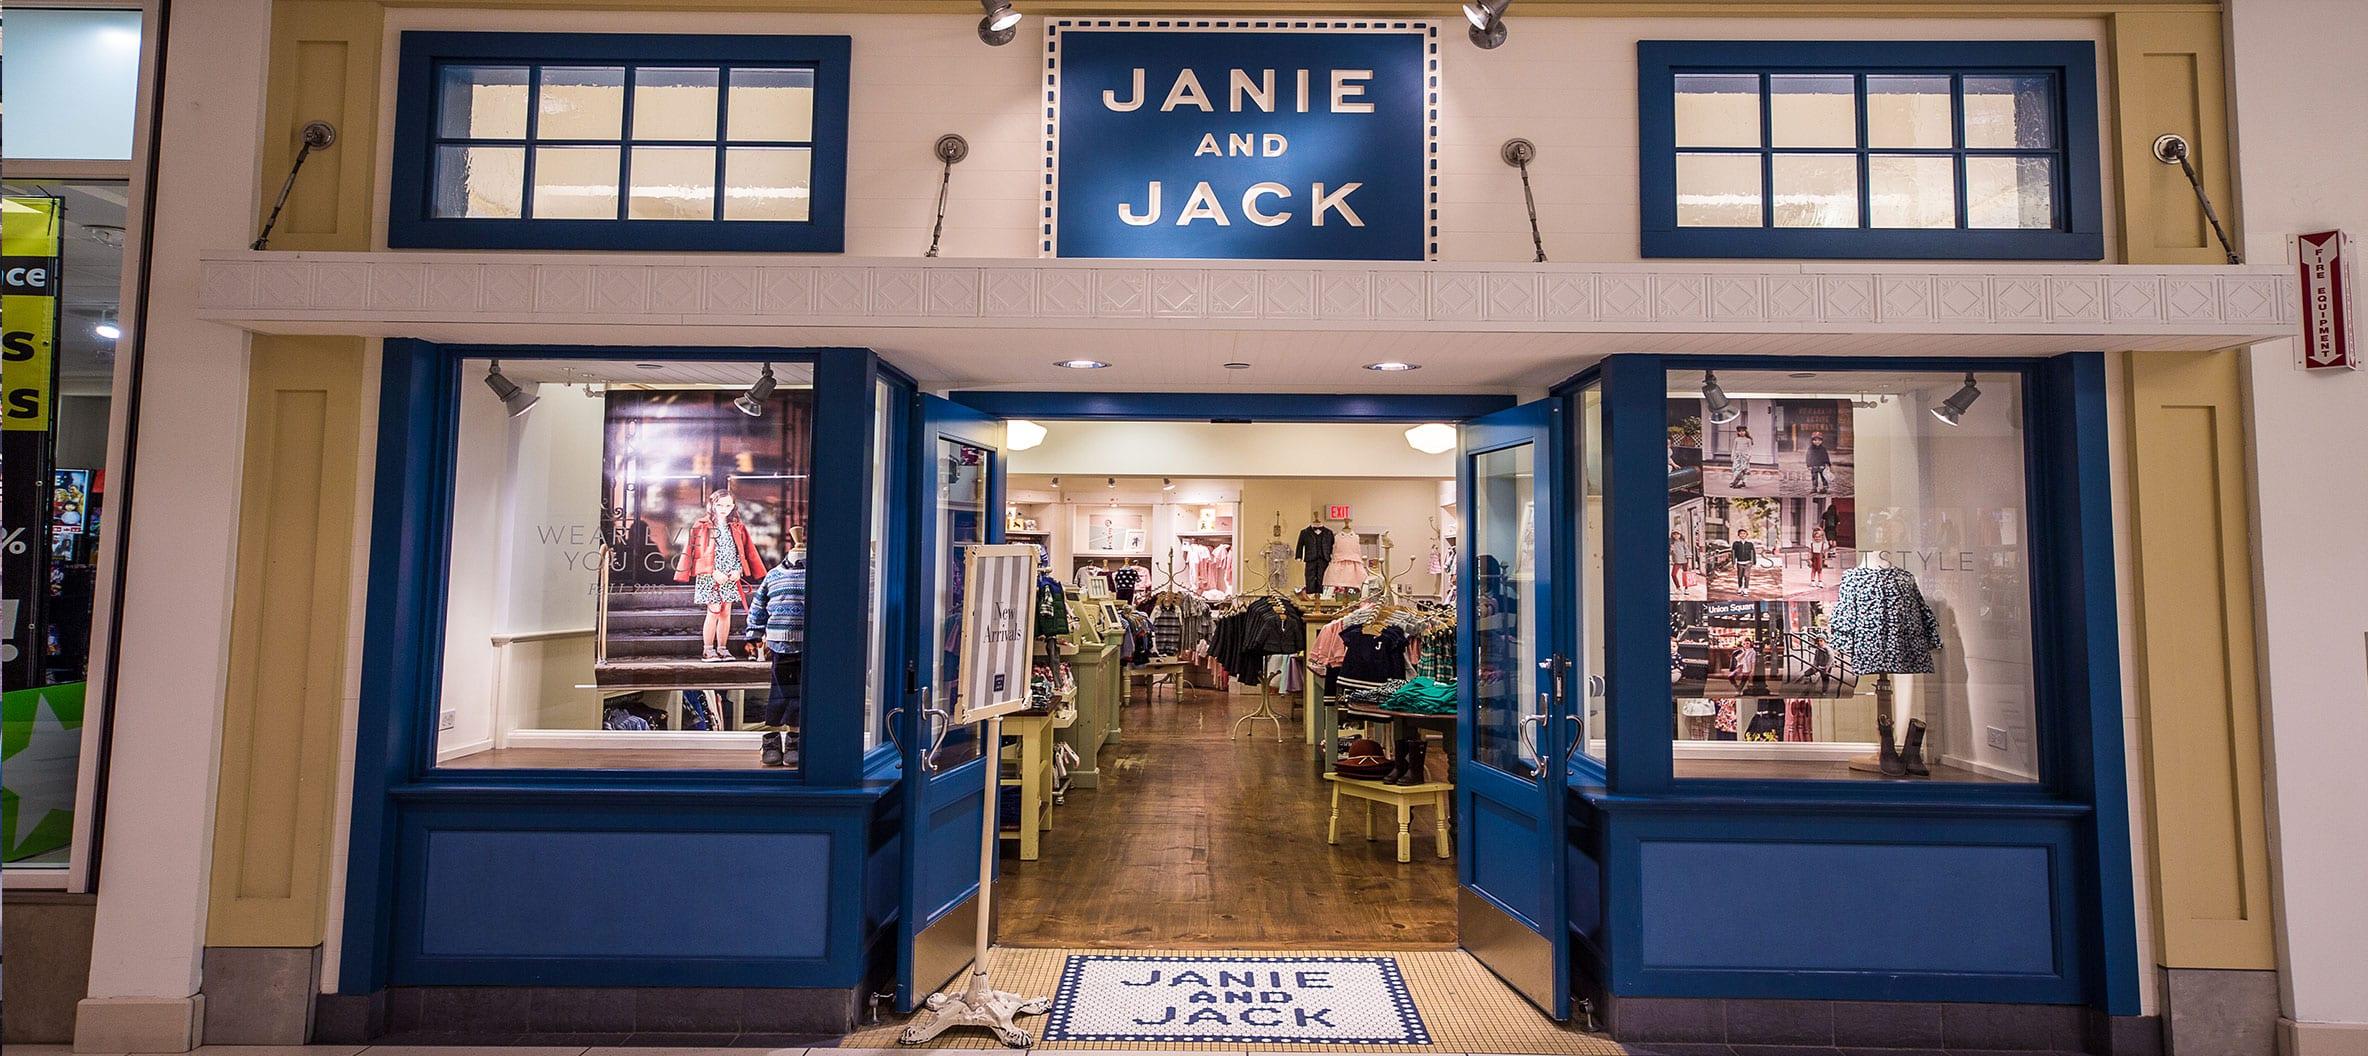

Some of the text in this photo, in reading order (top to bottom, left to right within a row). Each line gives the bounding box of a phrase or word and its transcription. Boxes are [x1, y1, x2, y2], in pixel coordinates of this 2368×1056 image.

[1102, 68, 1375, 113] JANIE
[1194, 133, 1289, 157] AND
[1117, 181, 1366, 227] JACK
[2, 266, 46, 287] ce
[2315, 248, 2329, 357] FIRE EQUIPMENT
[1331, 505, 1349, 518] EXIT
[537, 525, 628, 545] WEAR
[564, 551, 694, 573] YOU GO
[993, 601, 1016, 620] New
[1708, 604, 1729, 614] Union
[983, 622, 1022, 643] Arrivals
[1375, 641, 1382, 650] J
[1120, 970, 1334, 988] JANIE
[1188, 991, 1293, 1004] AND
[1132, 1006, 1336, 1028] JACK
